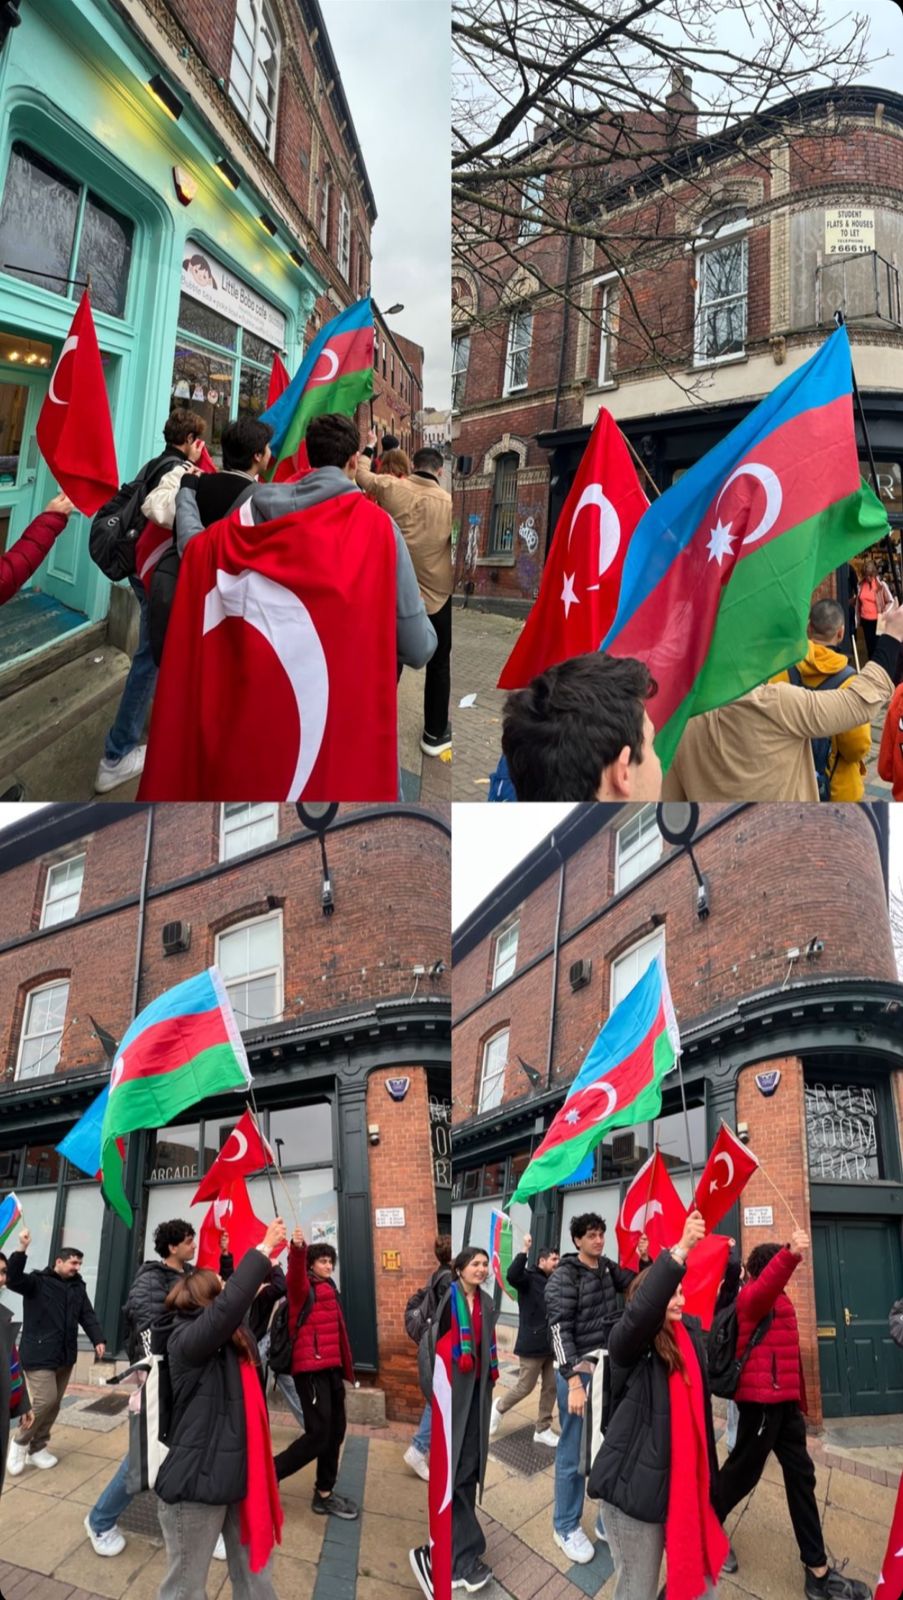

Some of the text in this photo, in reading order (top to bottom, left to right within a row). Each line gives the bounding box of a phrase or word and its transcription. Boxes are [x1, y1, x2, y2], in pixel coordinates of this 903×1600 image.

[838, 210, 862, 218] STUDENT
[826, 220, 874, 229] FLATS & HOUSES
[841, 229, 860, 237] TO LET
[221, 275, 239, 300] Little
[150, 1164, 197, 1180] ARCADE
[820, 1152, 868, 1180] BAR
